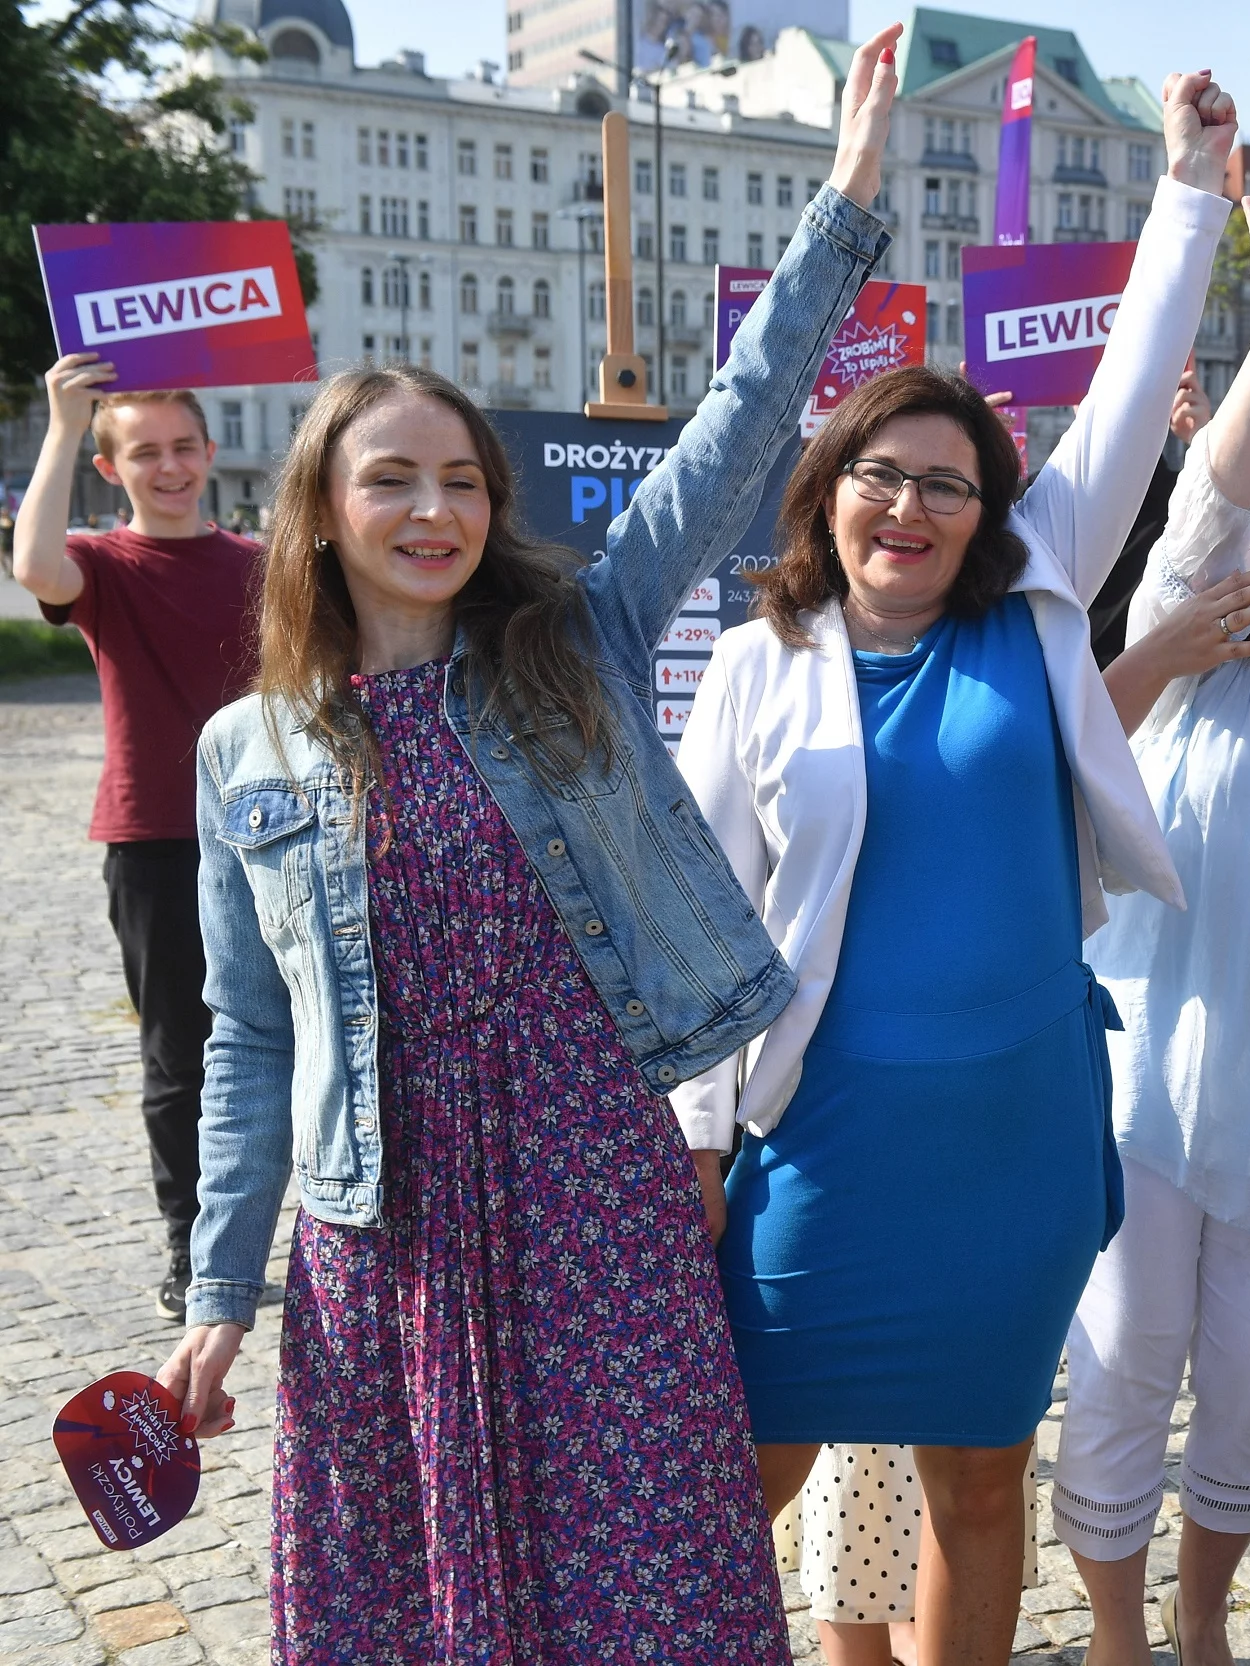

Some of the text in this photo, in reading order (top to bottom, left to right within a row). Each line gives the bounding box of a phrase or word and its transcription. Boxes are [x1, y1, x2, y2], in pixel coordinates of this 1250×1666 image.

[89, 276, 270, 335] LEWICA
[997, 302, 1120, 352] LEWIC
[844, 361, 858, 373] TO
[543, 439, 670, 471] DROŻYZ
[675, 628, 716, 642] +29%
[674, 670, 704, 683] +116
[88, 1462, 143, 1540] Polityczki
[109, 1457, 161, 1527] LEWICY
[95, 1511, 116, 1541] LEWICA
